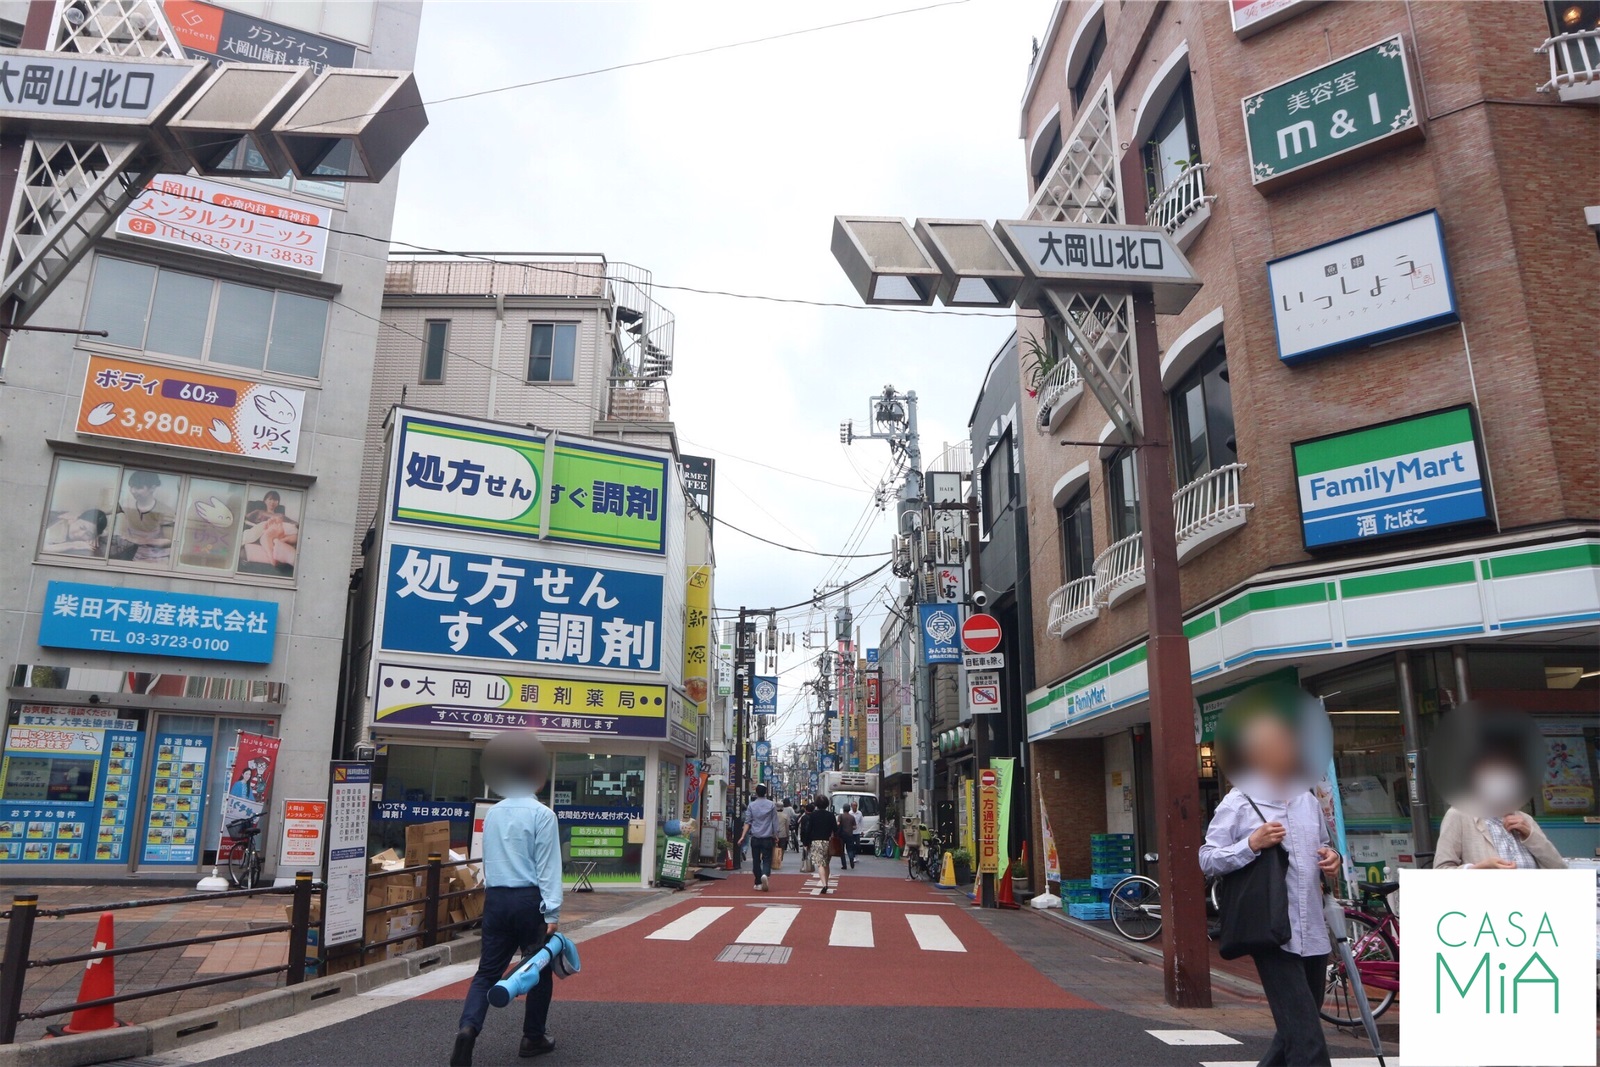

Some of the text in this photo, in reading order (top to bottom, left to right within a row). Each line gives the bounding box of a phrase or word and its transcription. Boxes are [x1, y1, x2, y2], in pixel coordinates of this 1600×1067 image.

[172, 24, 216, 41] ranTeeth
[248, 25, 329, 59] グランティース
[0, 60, 155, 110] 大岡山北口
[1287, 71, 1359, 115] 美容室
[1329, 109, 1358, 139] &
[143, 180, 204, 203] 大岡山
[135, 198, 313, 246] メンタルクリニック
[220, 196, 312, 224] 心療内科・精神科
[132, 220, 151, 232] 3F
[1038, 231, 1164, 270] 大岡山北口
[1282, 254, 1415, 311] いっしょう
[1295, 294, 1411, 331] イッショウケンメイ
[96, 369, 159, 396] ボディ
[179, 383, 219, 404] 60分
[120, 407, 203, 437] 3,980円
[253, 424, 292, 444] りらく
[251, 441, 290, 455] スペース
[405, 451, 532, 501] 処方せん
[684, 471, 708, 480] RMET
[1310, 450, 1465, 501] FamilyMart
[549, 480, 659, 521] すぐ調剤
[1356, 507, 1428, 537] 酒 たばこ
[396, 549, 620, 610] 処方せん
[52, 593, 269, 635] 柴田不動産株式会社
[90, 628, 230, 652] TEL 03-3723-0100
[439, 610, 655, 669] すぐ調剤
[966, 656, 1002, 667] 自転車を除く
[22, 705, 116, 717] お気軽にご相談ください
[1074, 684, 1106, 713] FamilyMart
[23, 715, 56, 726] 東工大
[437, 709, 614, 730] すべての処方せん すぐ調剤します
[11, 728, 75, 741] 画面にタッチして
[11, 738, 73, 750] 物件が探せます
[164, 737, 203, 747] 特選物件
[11, 810, 77, 819] おすすめ物件
[377, 803, 407, 811] いつでも
[579, 828, 617, 836] 処方せん調剤
[982, 790, 995, 857] 一方通行出口
[666, 843, 684, 860] 薬
